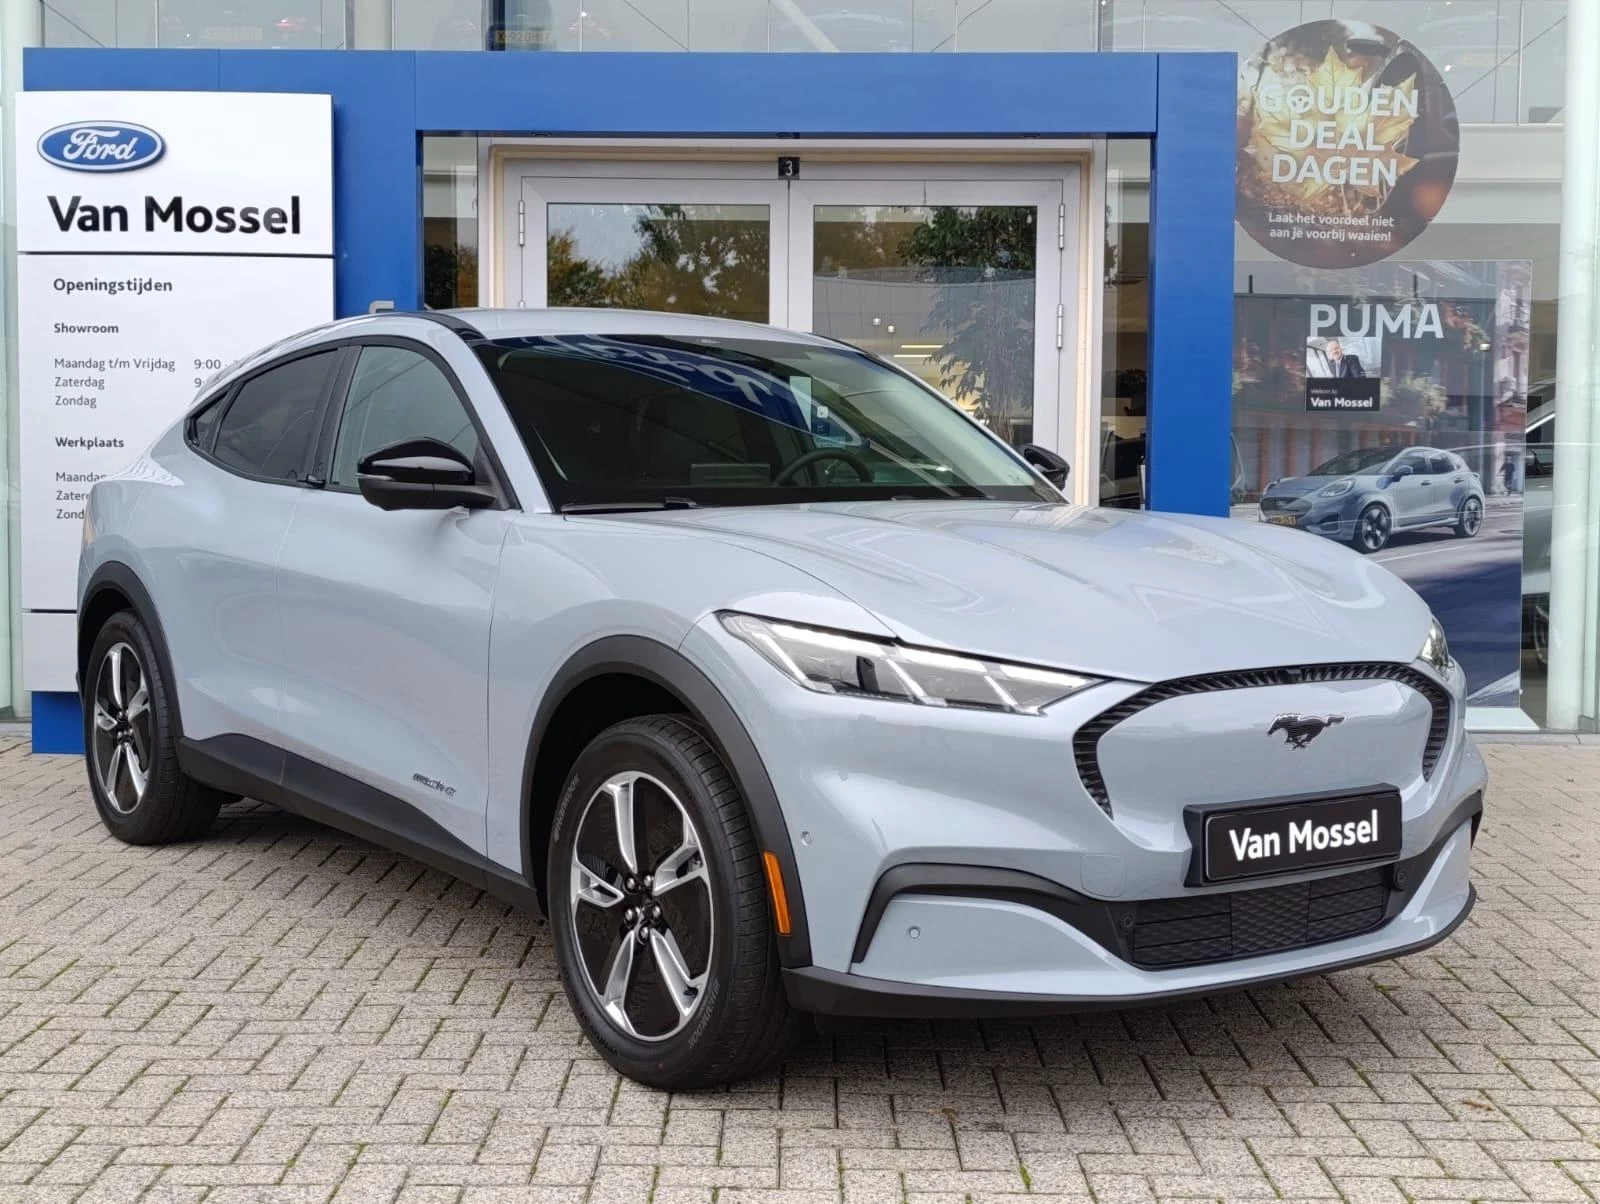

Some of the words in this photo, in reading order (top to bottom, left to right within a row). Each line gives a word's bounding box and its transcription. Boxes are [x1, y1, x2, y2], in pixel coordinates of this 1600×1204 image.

[1259, 83, 1420, 118] GOUDEN
[1289, 119, 1385, 152] DEAL
[63, 128, 138, 161] Ford
[785, 160, 793, 176] 3
[1272, 153, 1398, 187] DAGEN
[47, 194, 128, 232] Van
[144, 195, 300, 235] Mossel
[1268, 211, 1294, 224] Laat
[1296, 212, 1316, 224] het
[1318, 213, 1369, 227] voordeel
[1371, 215, 1395, 228] niet
[1269, 228, 1290, 239] aan
[1291, 226, 1304, 240] je
[1305, 228, 1345, 242] voorbij
[1347, 230, 1392, 242] waaien!
[53, 277, 173, 296] Openingstijden
[53, 322, 119, 334] Showroom
[1309, 303, 1444, 339] PUMA
[54, 357, 106, 372] Maandag
[108, 357, 130, 369] t/m
[133, 358, 176, 373] Vrijdag
[193, 358, 222, 370] 9:00
[54, 375, 105, 391] Zaterdag
[54, 394, 97, 409] Zondag
[1310, 396, 1332, 408] Van
[1334, 396, 1373, 408] Mossel
[54, 436, 125, 451] Werkplaats
[55, 471, 107, 482] Maanda
[55, 490, 90, 501] Zater
[56, 508, 85, 520] Zond
[1228, 827, 1281, 862] Van
[1288, 808, 1378, 854] Mossel
